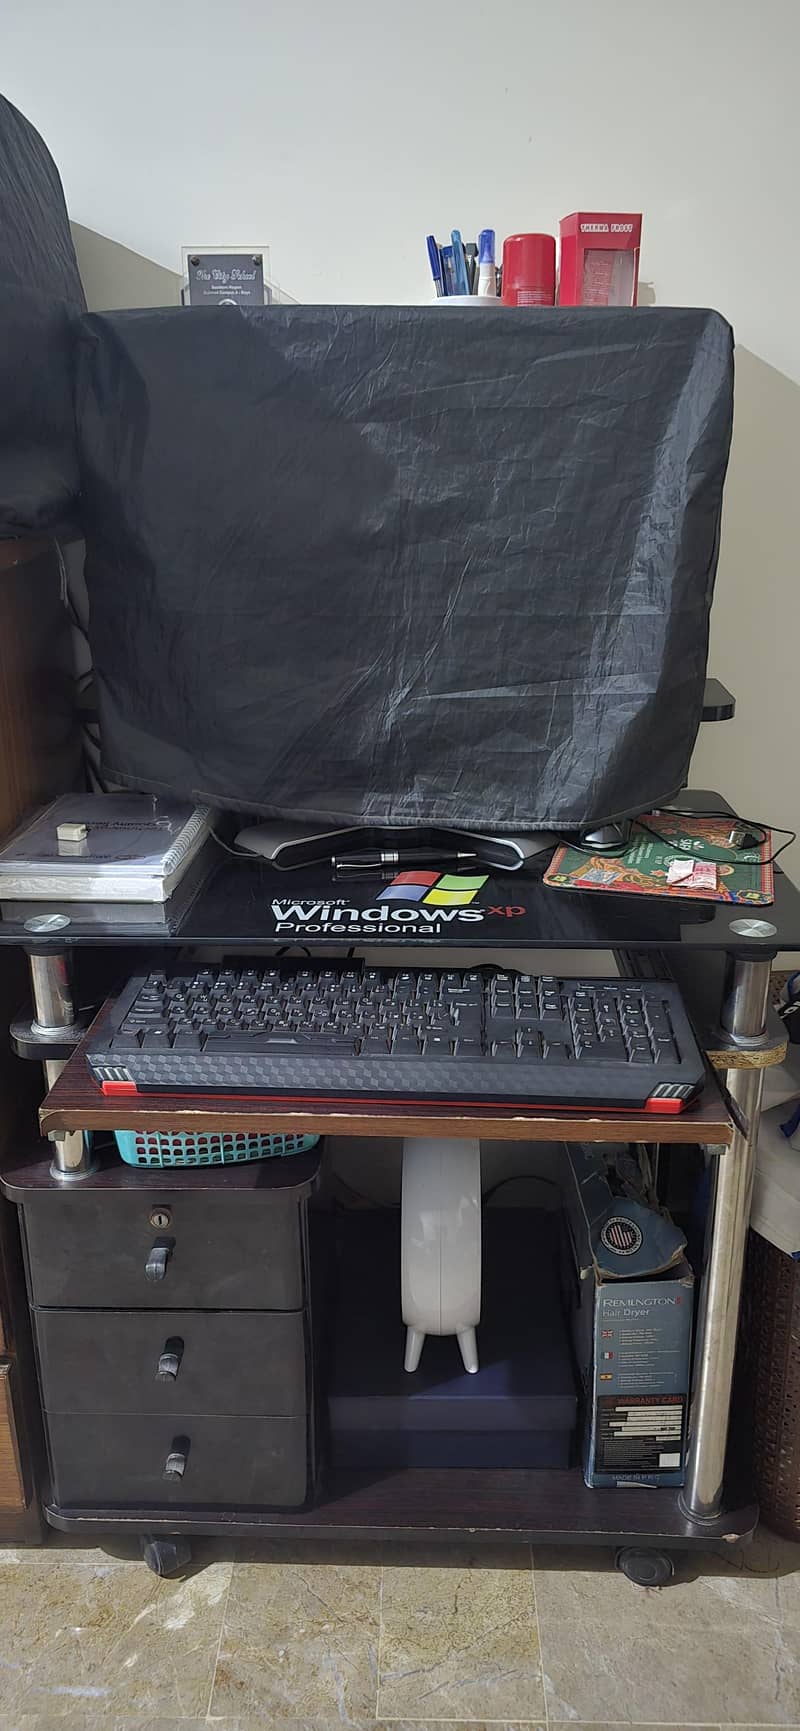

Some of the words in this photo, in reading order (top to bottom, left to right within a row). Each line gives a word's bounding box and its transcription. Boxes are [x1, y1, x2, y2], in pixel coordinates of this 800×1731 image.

[580, 223, 609, 233] THERMA
[610, 223, 633, 233] FROST
[231, 269, 257, 281] School
[270, 905, 486, 922] Windows
[274, 922, 441, 934] Professional
[603, 1297, 676, 1307] REMINGTON
[602, 1309, 621, 1318] Hair
[623, 1308, 650, 1318] Dryer
